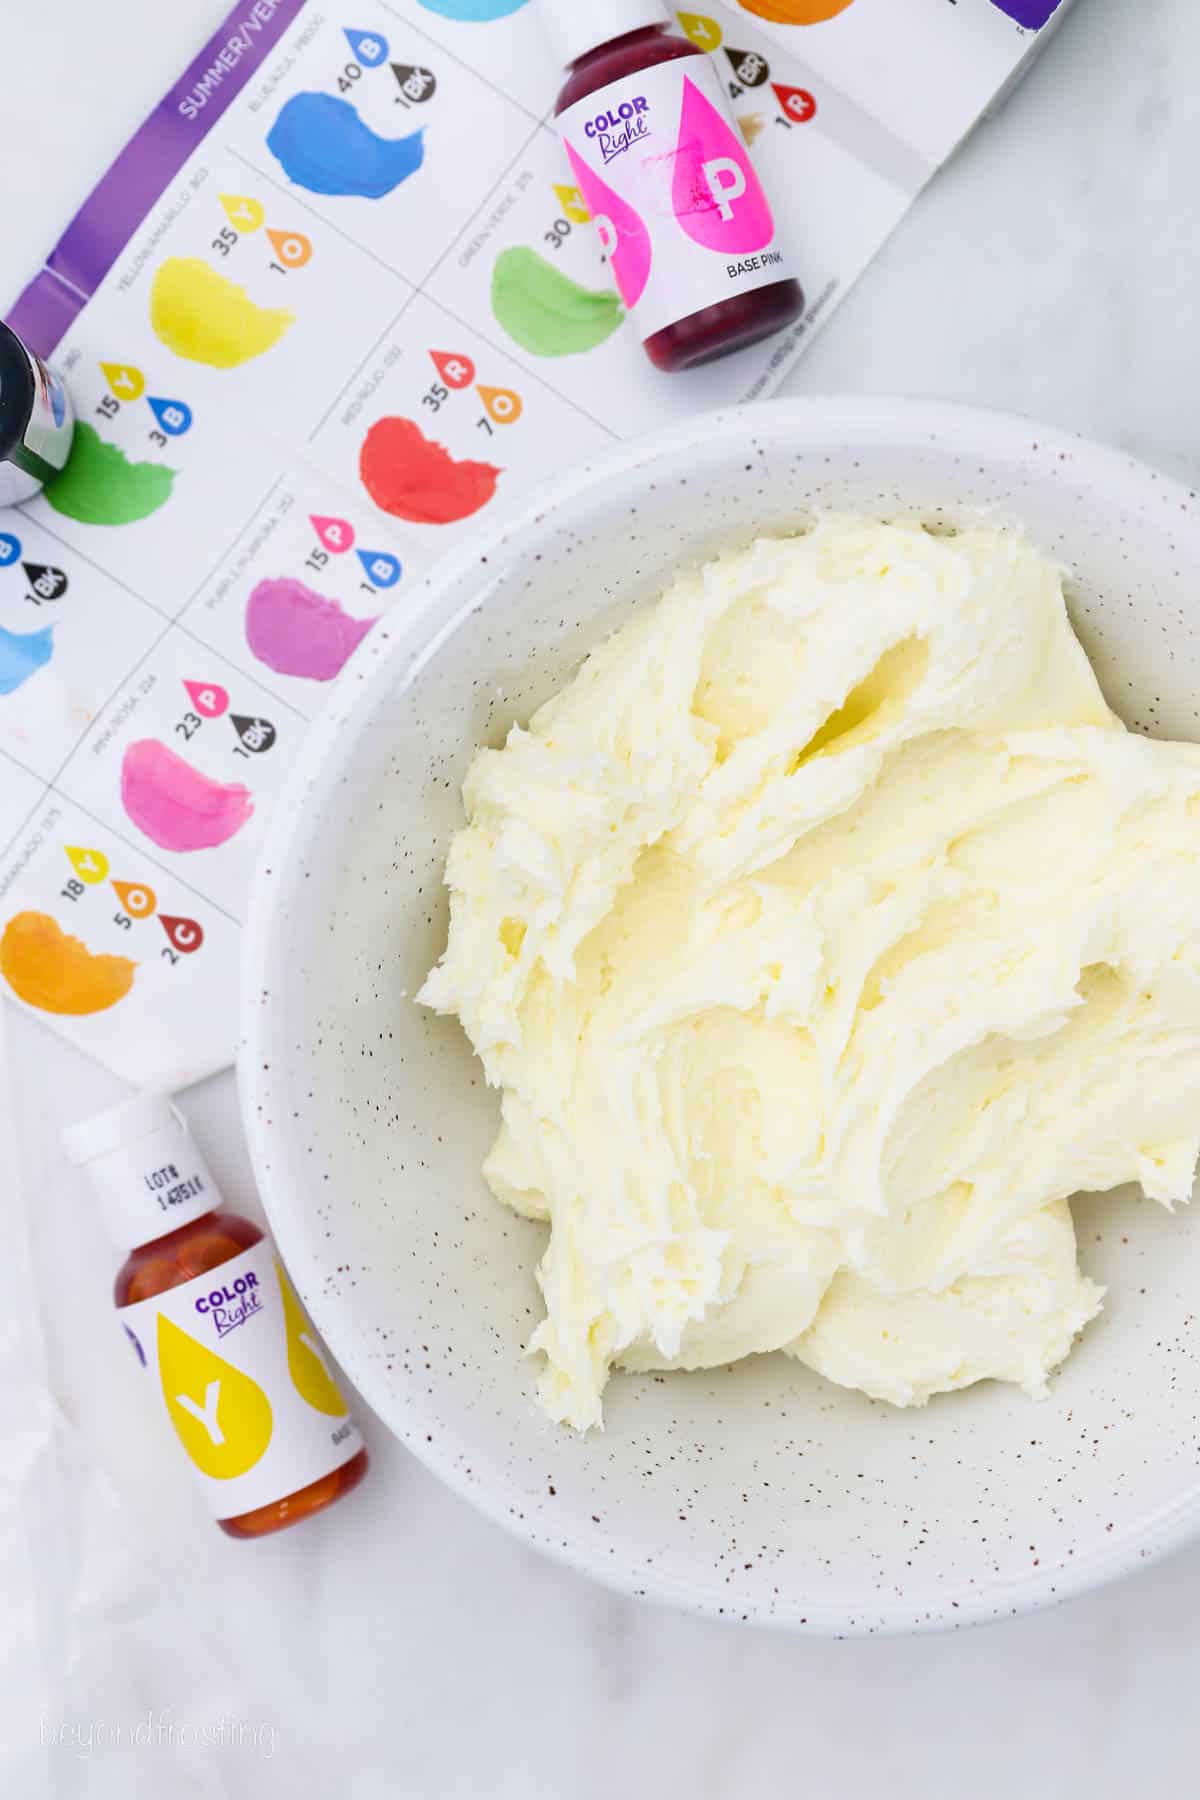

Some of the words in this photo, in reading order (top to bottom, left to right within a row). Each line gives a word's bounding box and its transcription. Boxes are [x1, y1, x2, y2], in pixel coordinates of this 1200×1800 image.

[692, 20, 712, 39] Y
[337, 63, 362, 93] 40
[358, 38, 382, 61] B
[728, 81, 745, 100] 4
[737, 53, 766, 85] BR
[394, 96, 411, 110] 1
[403, 69, 435, 101] BK
[584, 95, 650, 138] COLOR
[775, 116, 792, 129] 1
[785, 94, 810, 116] R
[597, 116, 651, 163] Right
[701, 156, 747, 223] P
[211, 226, 239, 256] 35
[232, 203, 254, 222] Y
[543, 218, 573, 250] 30
[269, 261, 287, 275] 1
[280, 238, 304, 261] O
[726, 256, 761, 279] BASE
[760, 249, 785, 267] PINK
[95, 394, 121, 420] 15
[113, 370, 137, 391] Y
[422, 383, 449, 414] 35
[444, 359, 469, 382] R
[148, 431, 168, 448] 3
[161, 407, 186, 430] B
[476, 415, 495, 437] 7
[490, 394, 514, 417] O
[304, 547, 329, 572] 15
[324, 524, 345, 547] P
[32, 566, 66, 597] BK
[360, 580, 378, 595] 1
[370, 558, 395, 581] B
[23, 592, 42, 606] 1
[175, 711, 202, 742] 23
[197, 689, 217, 711] P
[240, 719, 274, 751] BK
[232, 746, 251, 759] 1
[60, 878, 85, 903] 18
[78, 853, 99, 873] Y
[113, 912, 133, 931] 5
[127, 888, 149, 911] O
[161, 947, 181, 966] 2
[174, 923, 196, 945] C
[194, 1271, 260, 1314] COLOR
[211, 1291, 263, 1337] Right
[174, 1380, 227, 1447] Y
